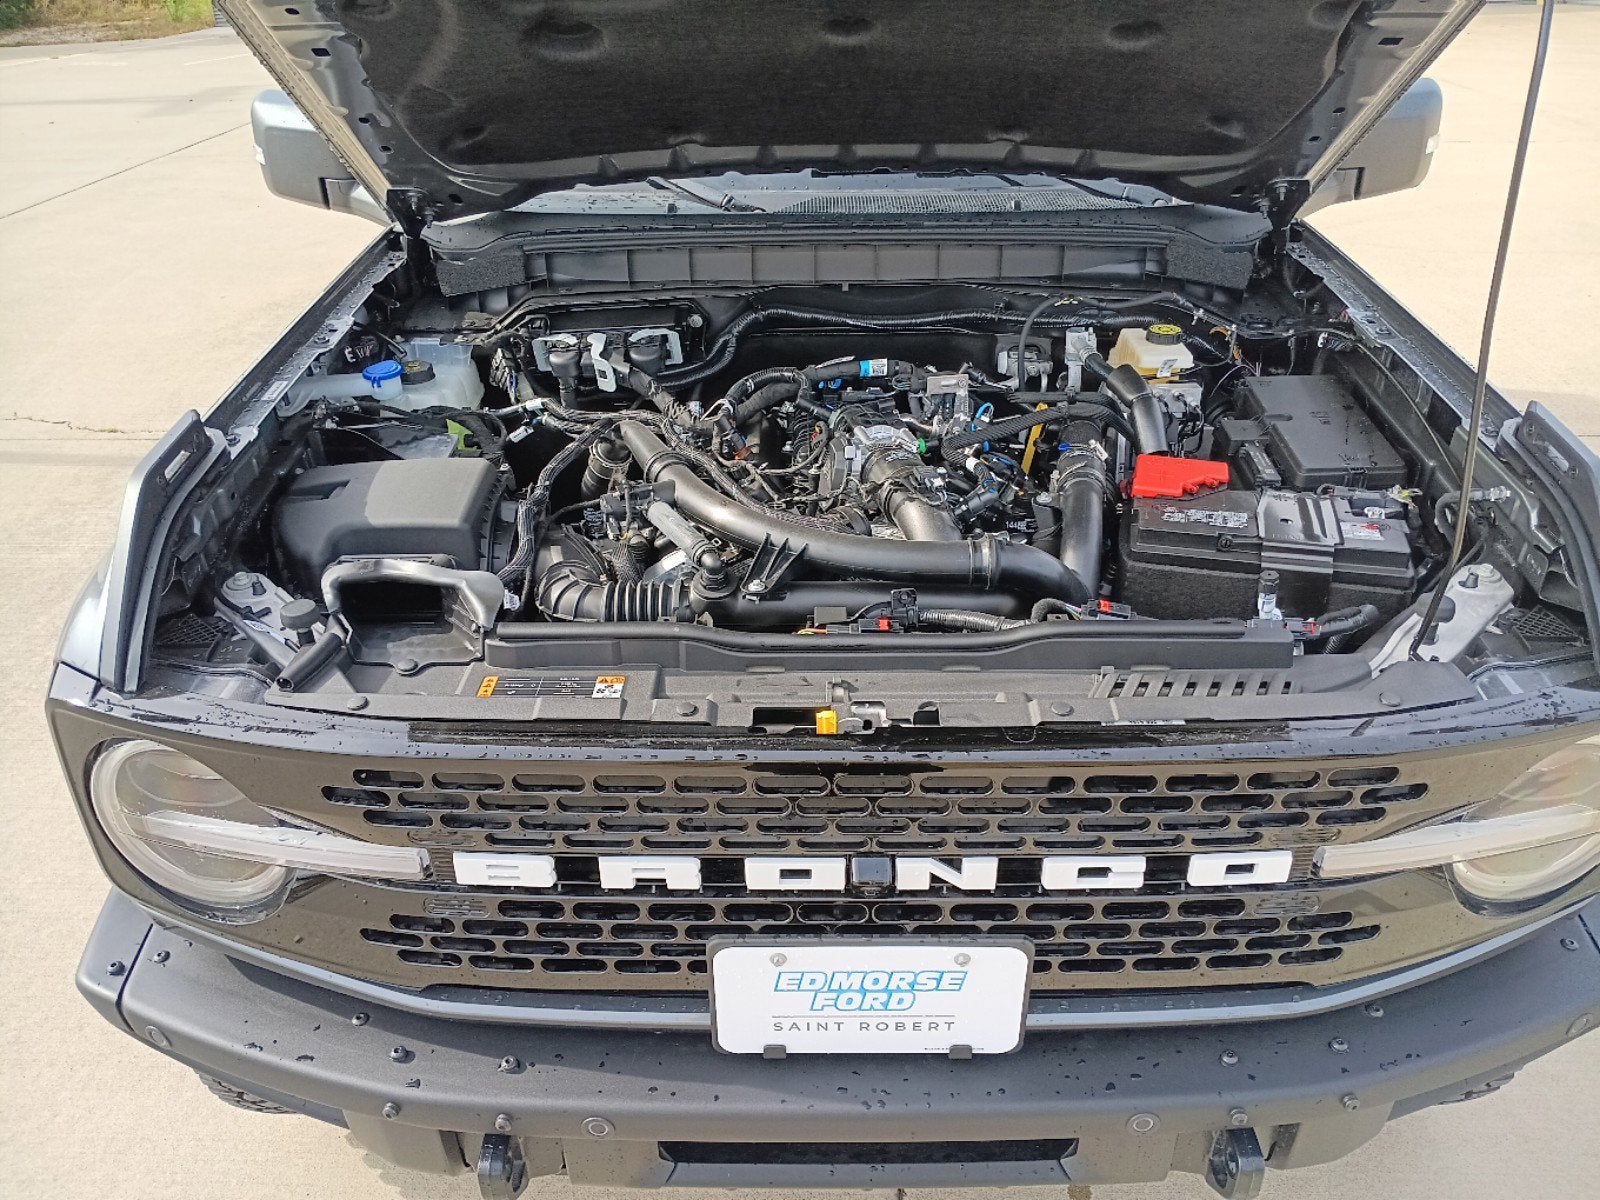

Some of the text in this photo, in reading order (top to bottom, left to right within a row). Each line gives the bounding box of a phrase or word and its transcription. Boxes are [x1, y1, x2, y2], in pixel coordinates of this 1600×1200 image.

[453, 850, 1293, 891] BRONCO
[774, 971, 968, 992] ED MORSE
[810, 991, 916, 1011] FORD
[773, 1021, 955, 1032] SAINT ROBERT
